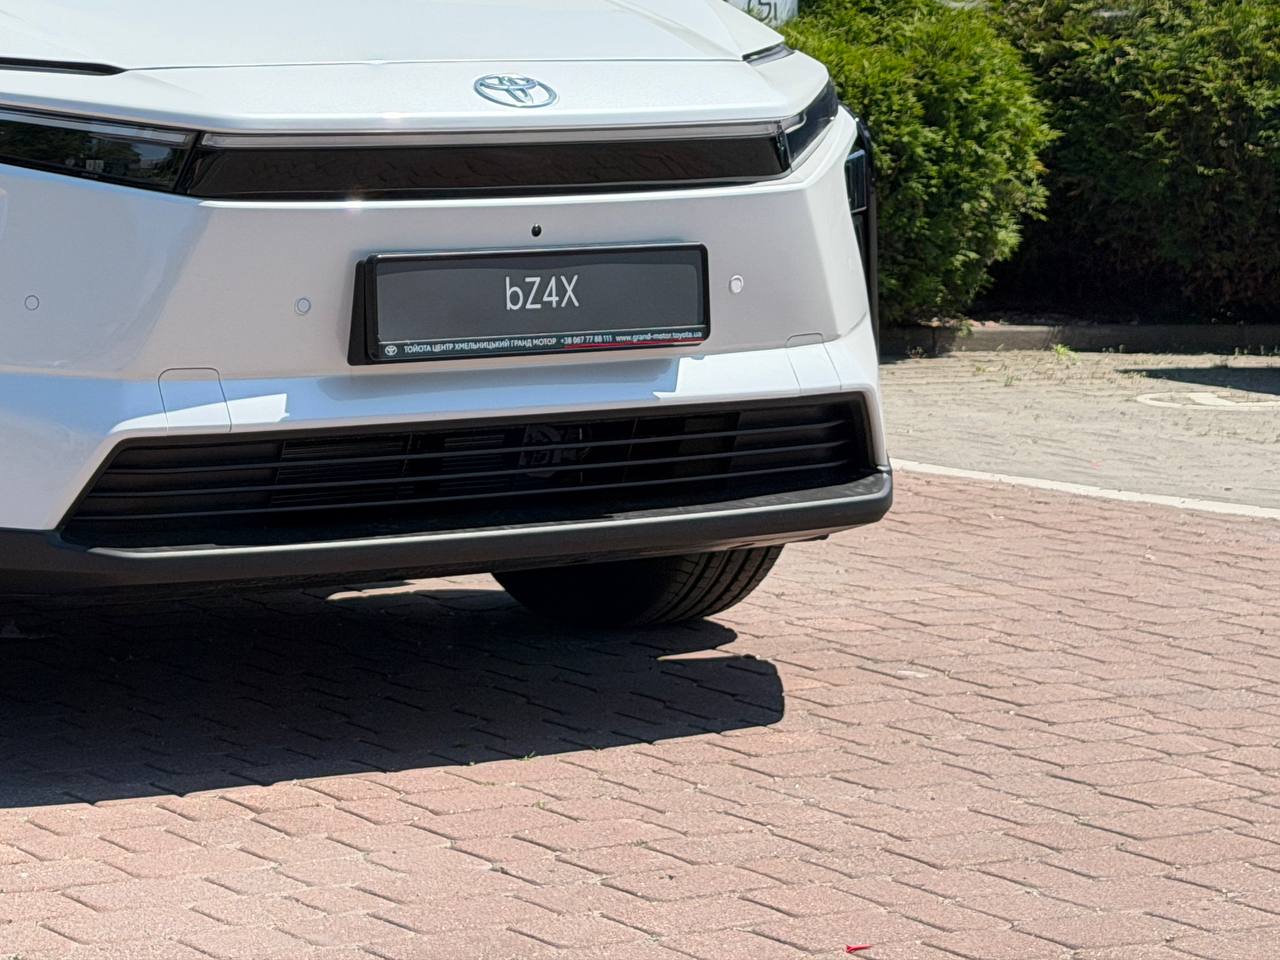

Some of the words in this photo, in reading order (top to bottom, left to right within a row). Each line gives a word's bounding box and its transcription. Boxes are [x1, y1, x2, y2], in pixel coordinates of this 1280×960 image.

[504, 274, 580, 311] bZ4X
[432, 342, 454, 352] ЦЕНТР
[510, 338, 533, 349] ГРАНД
[533, 337, 557, 347] МОТОР
